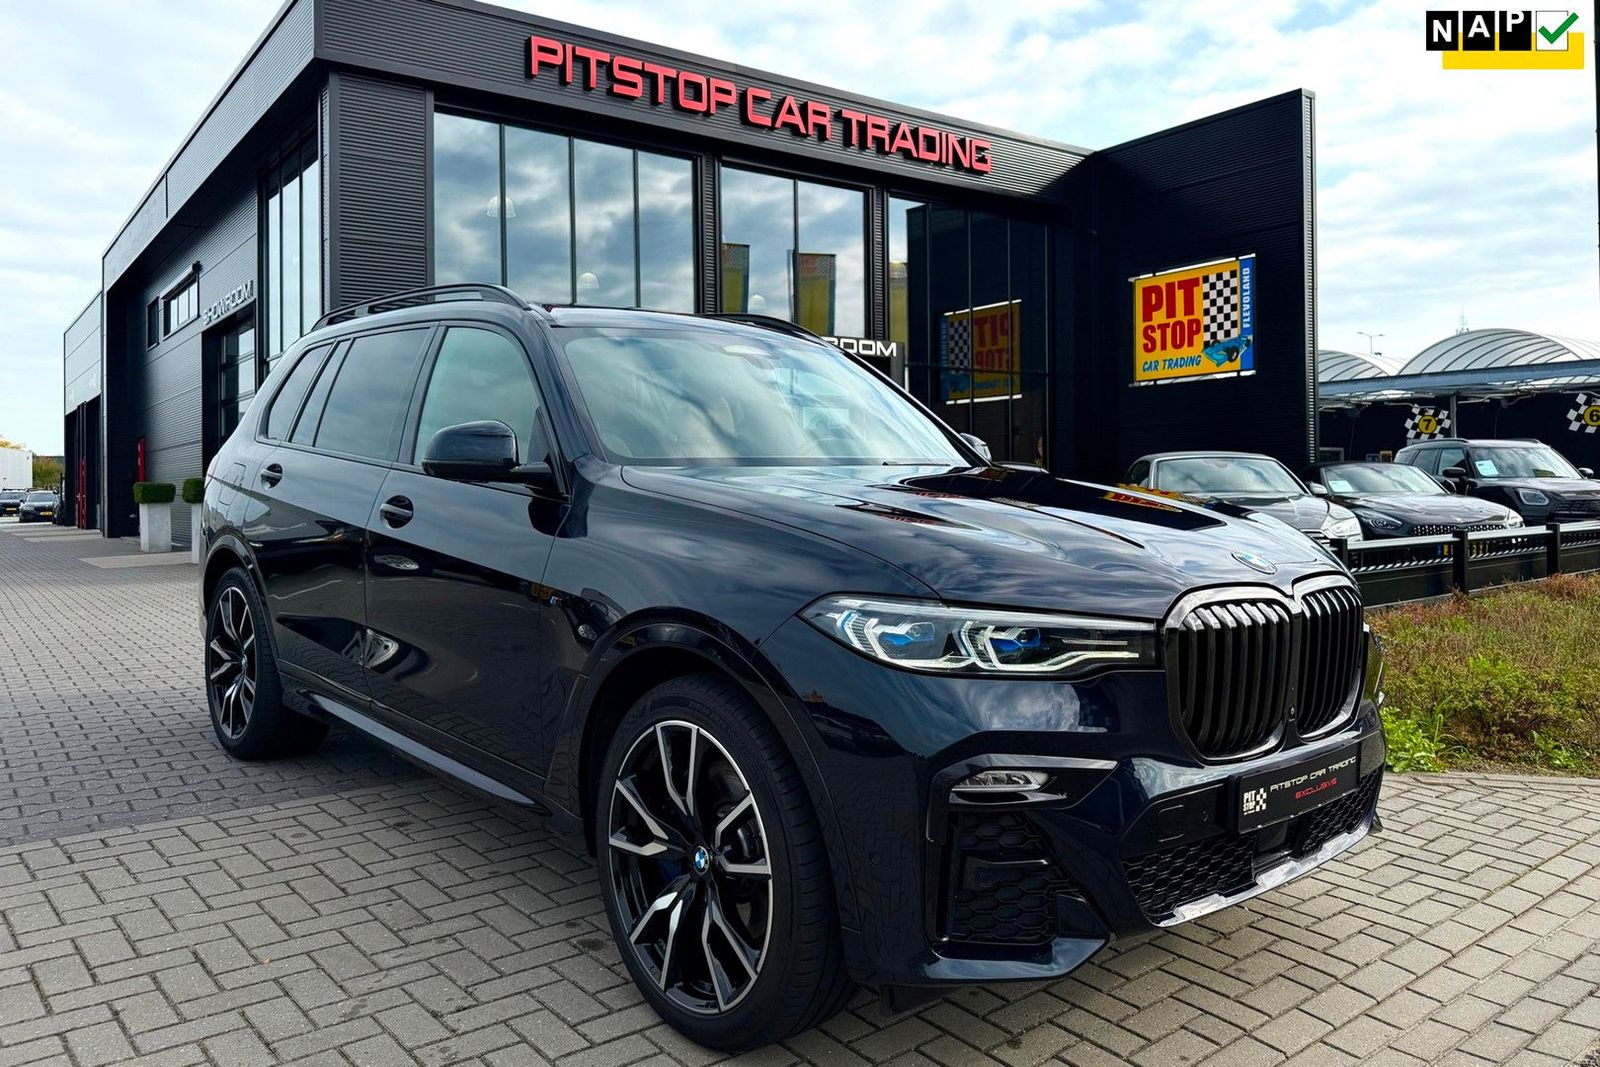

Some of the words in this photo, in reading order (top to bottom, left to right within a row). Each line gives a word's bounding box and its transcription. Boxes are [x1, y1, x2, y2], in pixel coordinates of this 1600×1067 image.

[527, 35, 736, 117] PITSTOP
[744, 87, 832, 141] CAR
[839, 109, 993, 174] TRADING
[203, 280, 253, 325] SHOWROOM
[1142, 277, 1200, 322] PIT
[1142, 318, 1201, 353] STOP
[1142, 360, 1159, 372] CAR
[1162, 355, 1201, 370] TRADING
[1422, 418, 1433, 430] 7
[1590, 410, 1600, 422] 6
[1270, 774, 1308, 792] PITSTOP
[1309, 768, 1326, 780] CAR
[1243, 790, 1256, 803] PIT
